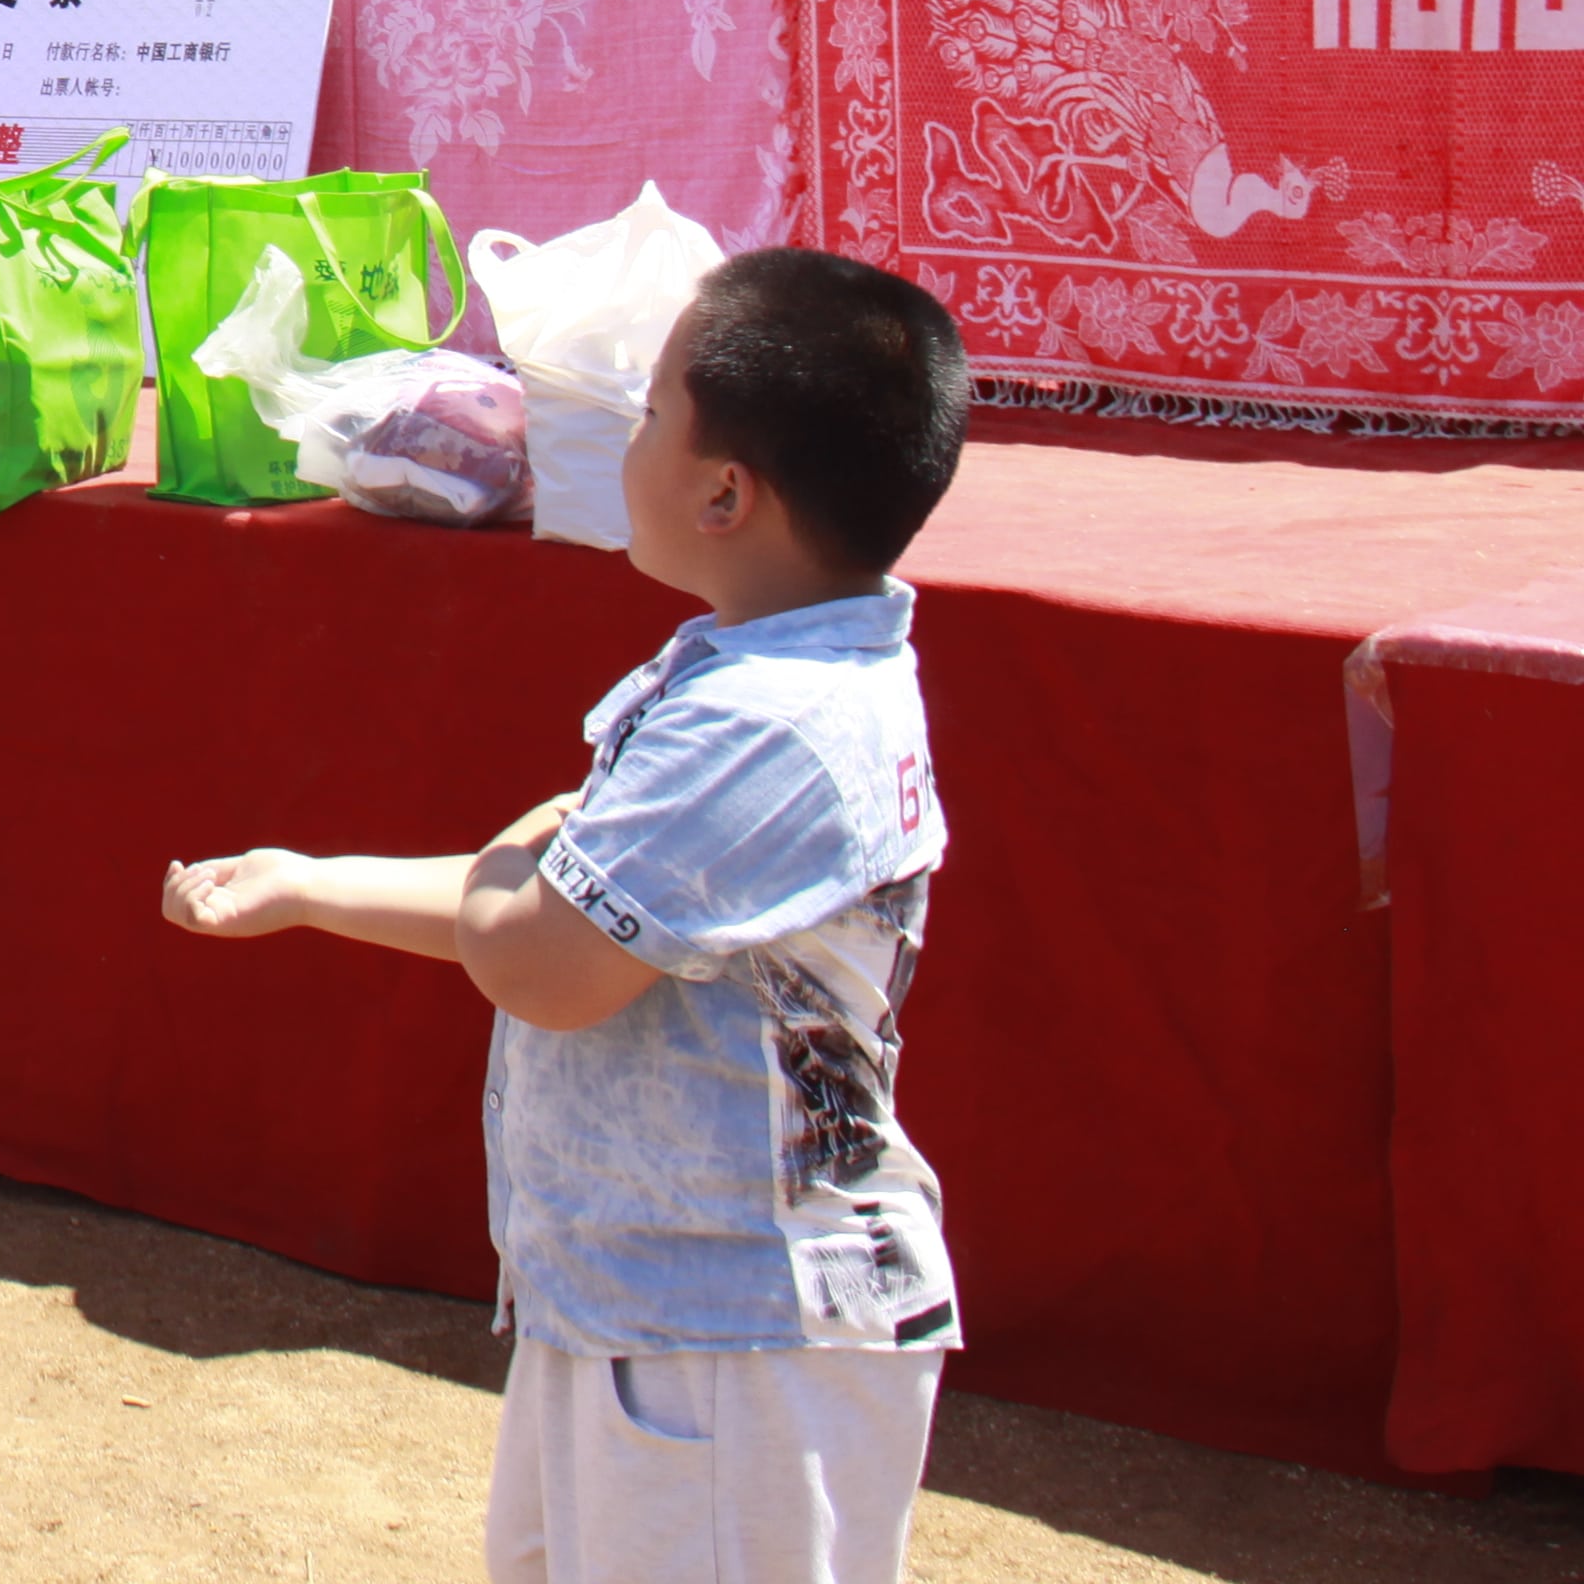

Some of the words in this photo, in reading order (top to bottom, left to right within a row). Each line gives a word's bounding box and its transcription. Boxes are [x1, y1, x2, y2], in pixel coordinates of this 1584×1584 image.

[136, 41, 232, 63] 中国工商银行
